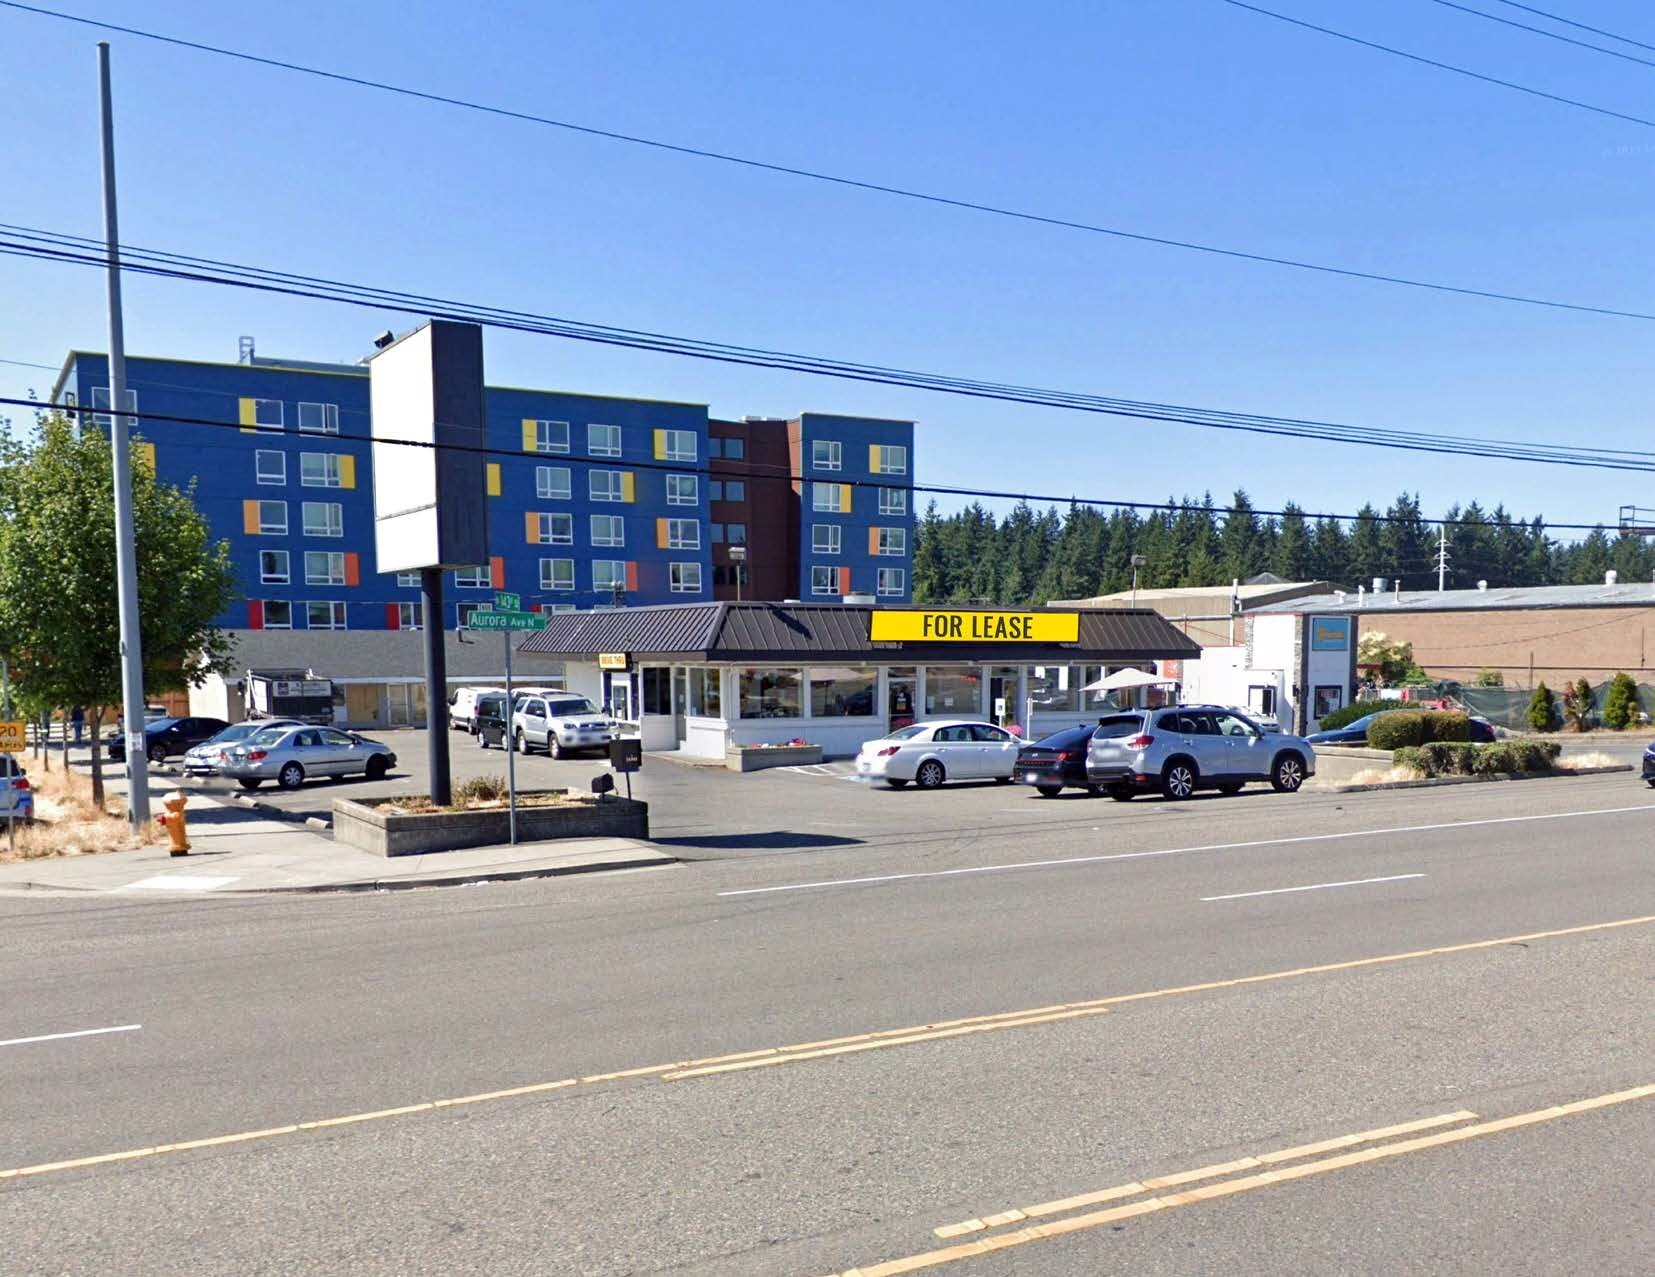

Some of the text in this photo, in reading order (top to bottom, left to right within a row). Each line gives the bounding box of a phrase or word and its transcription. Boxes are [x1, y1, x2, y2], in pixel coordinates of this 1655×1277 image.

[470, 612, 534, 627] Aurora Ave N
[923, 614, 1033, 639] FOR LEASE
